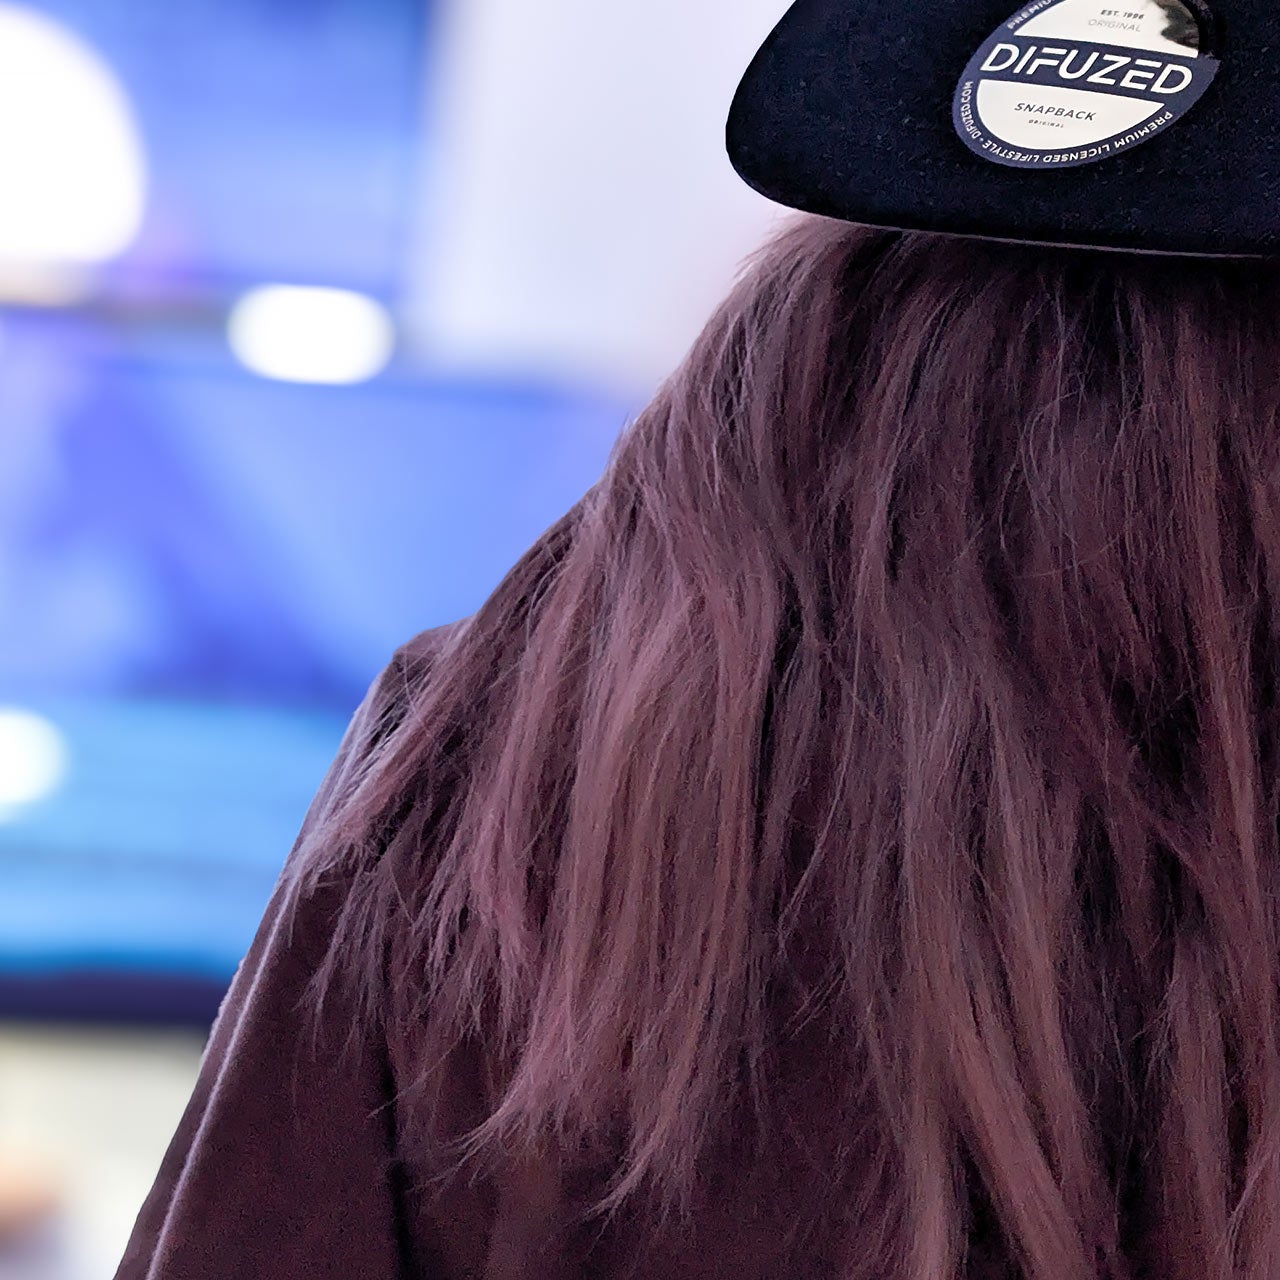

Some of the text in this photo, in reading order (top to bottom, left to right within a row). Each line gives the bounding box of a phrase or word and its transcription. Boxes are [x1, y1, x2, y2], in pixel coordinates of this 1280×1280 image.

[1100, 9, 1120, 17] EST.
[1088, 18, 1141, 32] ORIGINAL
[980, 43, 1193, 95] DIFUZED
[1014, 102, 1098, 121] SNAPBACK
[1114, 111, 1173, 149] PREMIUM
[982, 139, 1039, 162] LIFESTYLE
[1043, 143, 1111, 163] LICENSED
